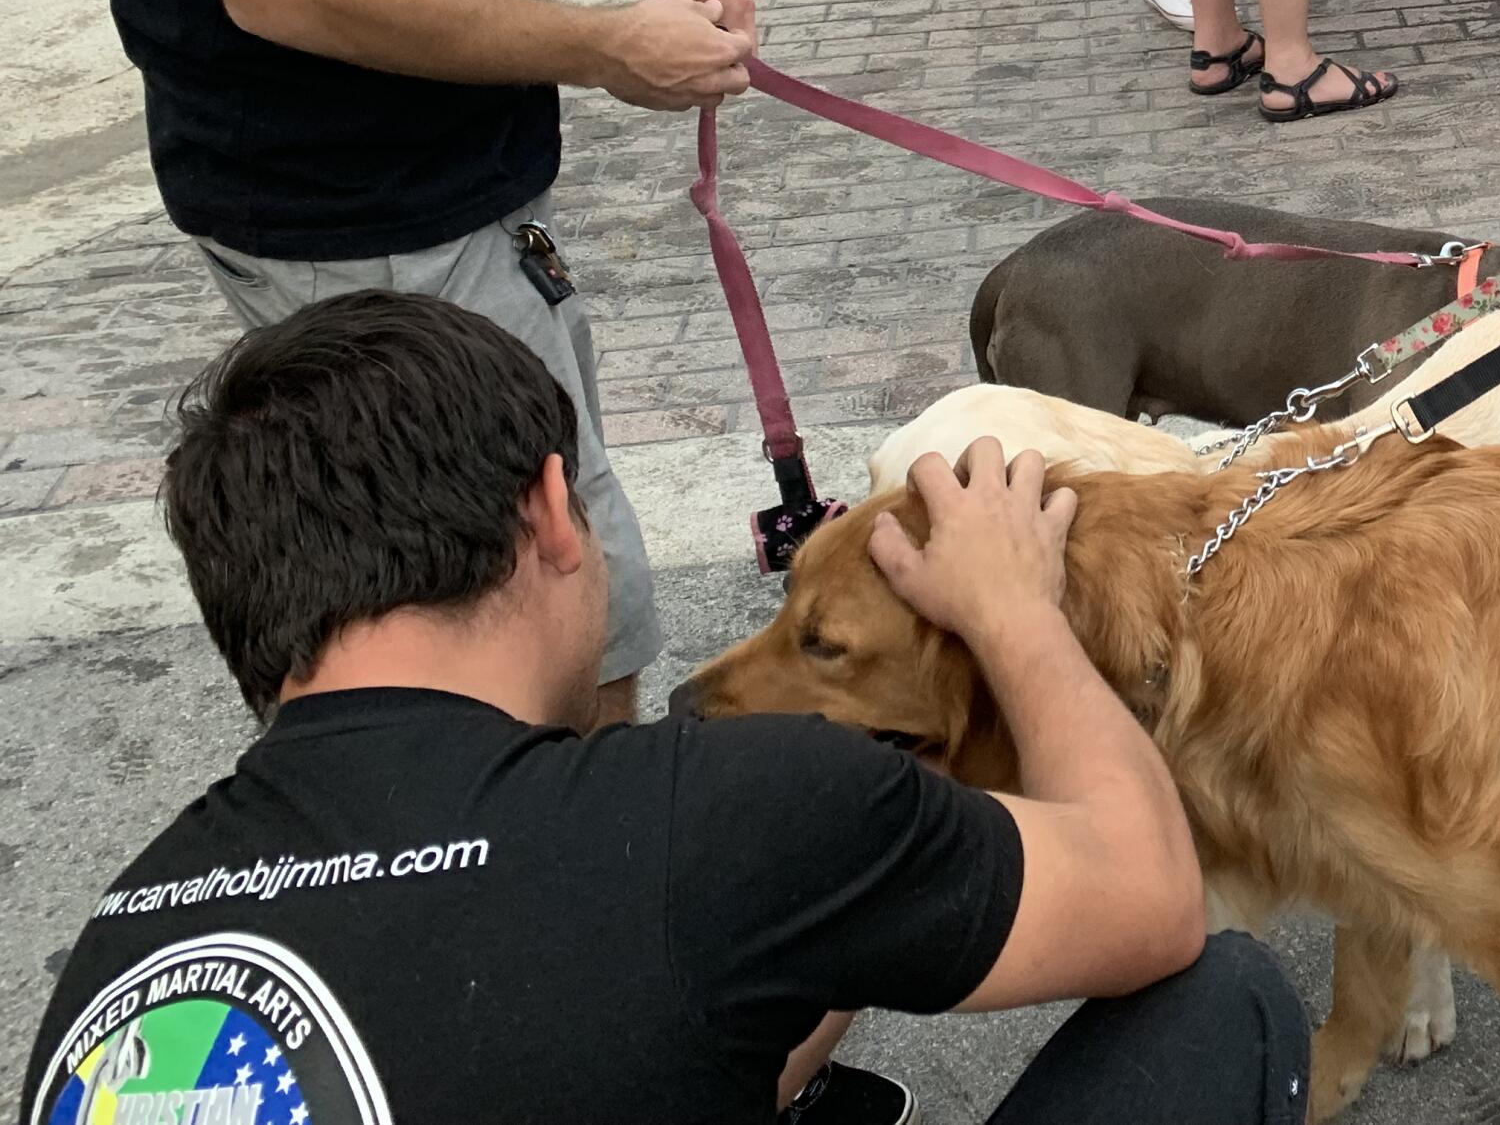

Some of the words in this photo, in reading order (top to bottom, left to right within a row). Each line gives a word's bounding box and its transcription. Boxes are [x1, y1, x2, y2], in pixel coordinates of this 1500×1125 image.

[91, 837, 490, 919] w.carvalhobjjmma.com
[65, 989, 141, 1075] MIXED
[145, 961, 250, 1006] MARTIAL
[248, 979, 312, 1050] ARTS
[110, 1081, 263, 1125] HRISTIAN
